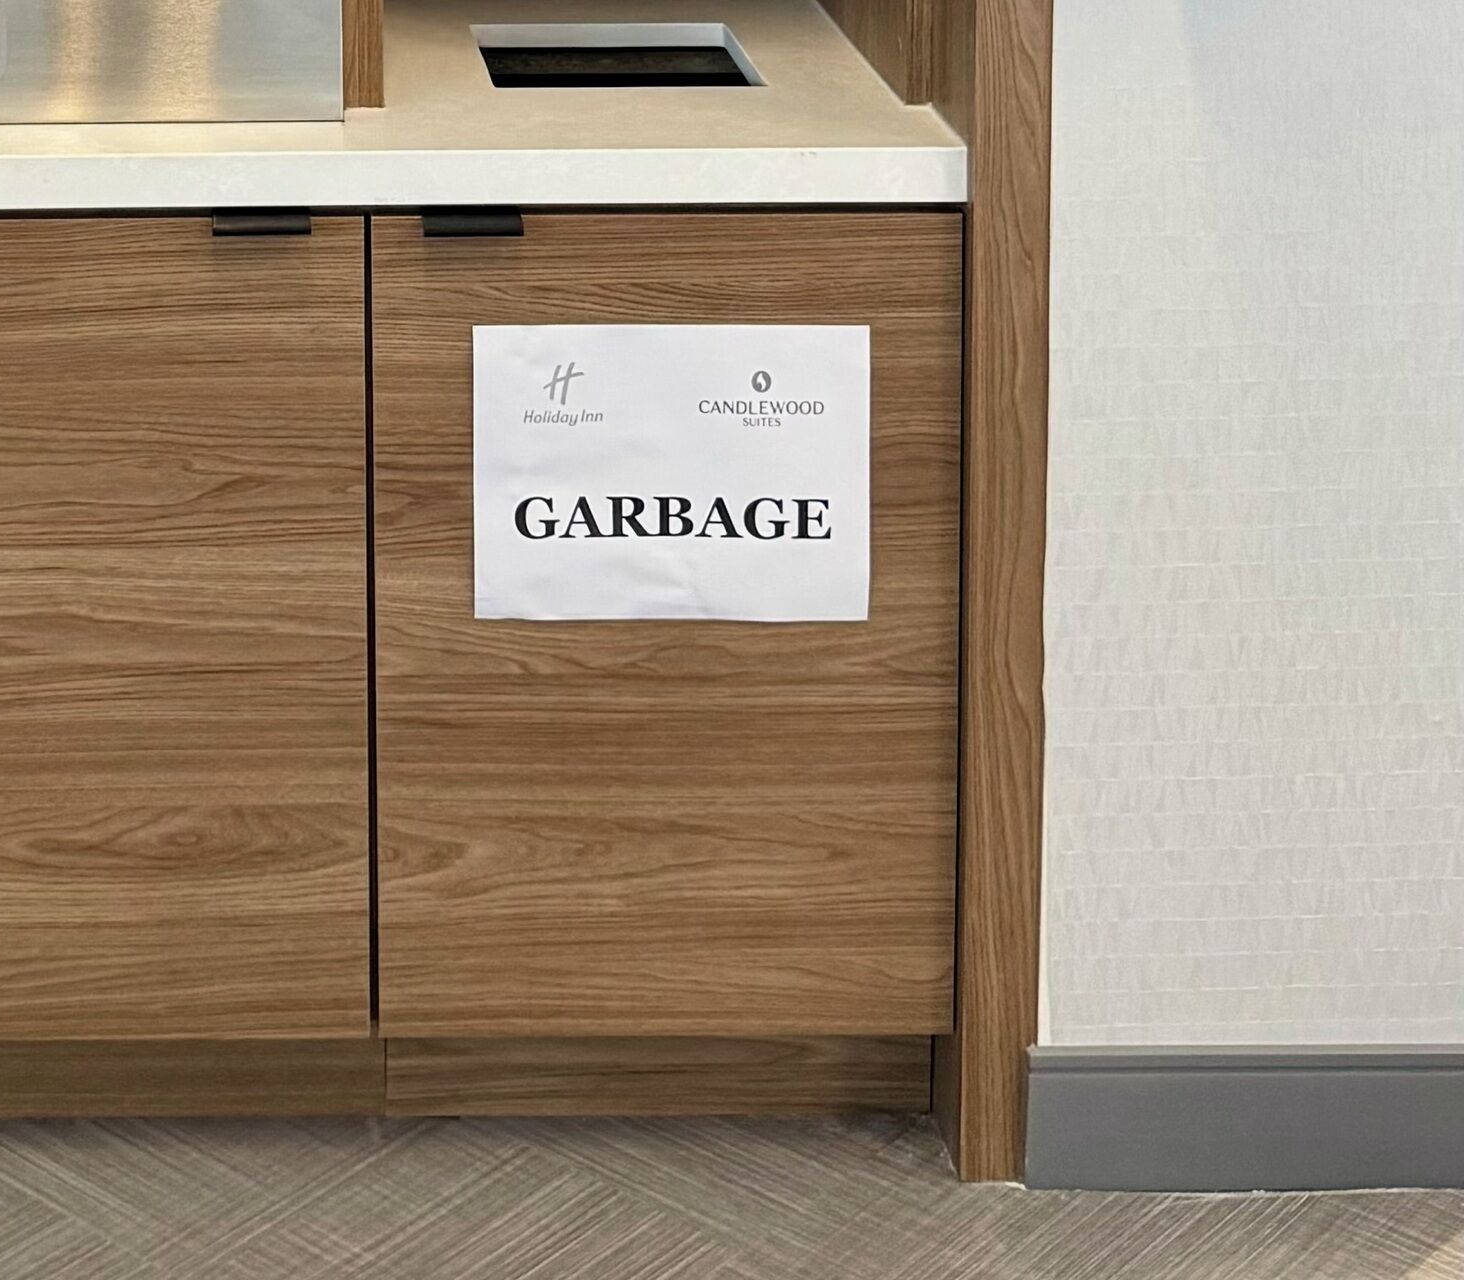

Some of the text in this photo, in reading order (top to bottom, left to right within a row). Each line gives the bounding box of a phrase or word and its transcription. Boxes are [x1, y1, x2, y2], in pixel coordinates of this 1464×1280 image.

[698, 399, 825, 416] CANDLEWOOD
[523, 409, 604, 427] Holiday Inn
[742, 417, 782, 427] SUITES
[513, 496, 833, 540] GARBAGE
